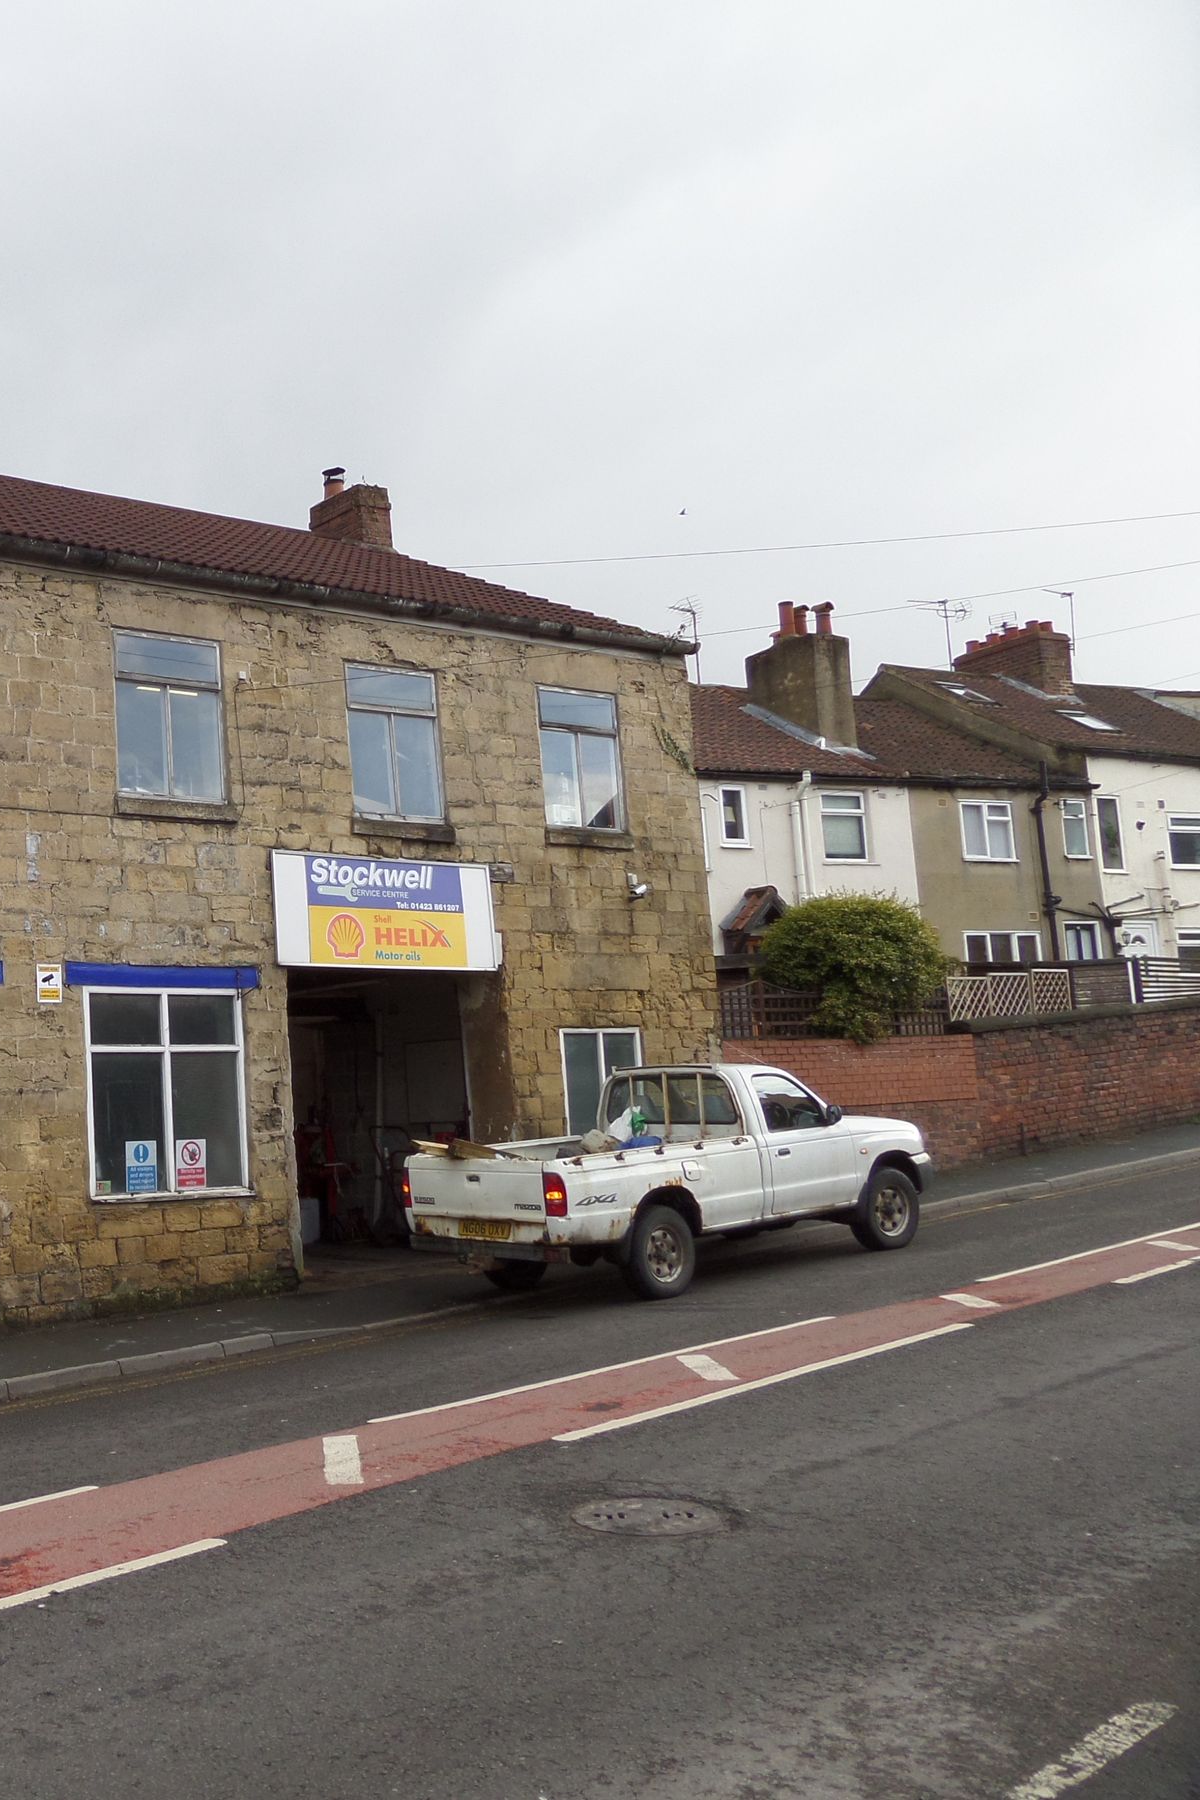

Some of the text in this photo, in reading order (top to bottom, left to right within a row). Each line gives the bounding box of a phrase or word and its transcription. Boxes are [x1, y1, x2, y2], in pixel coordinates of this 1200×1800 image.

[310, 858, 434, 890] Stockwell
[352, 889, 409, 899] SERVICE CENTRE
[373, 914, 392, 923] Shell
[374, 927, 449, 948] HELIX
[375, 950, 421, 961] Motor oils
[463, 1222, 486, 1234] NG06
